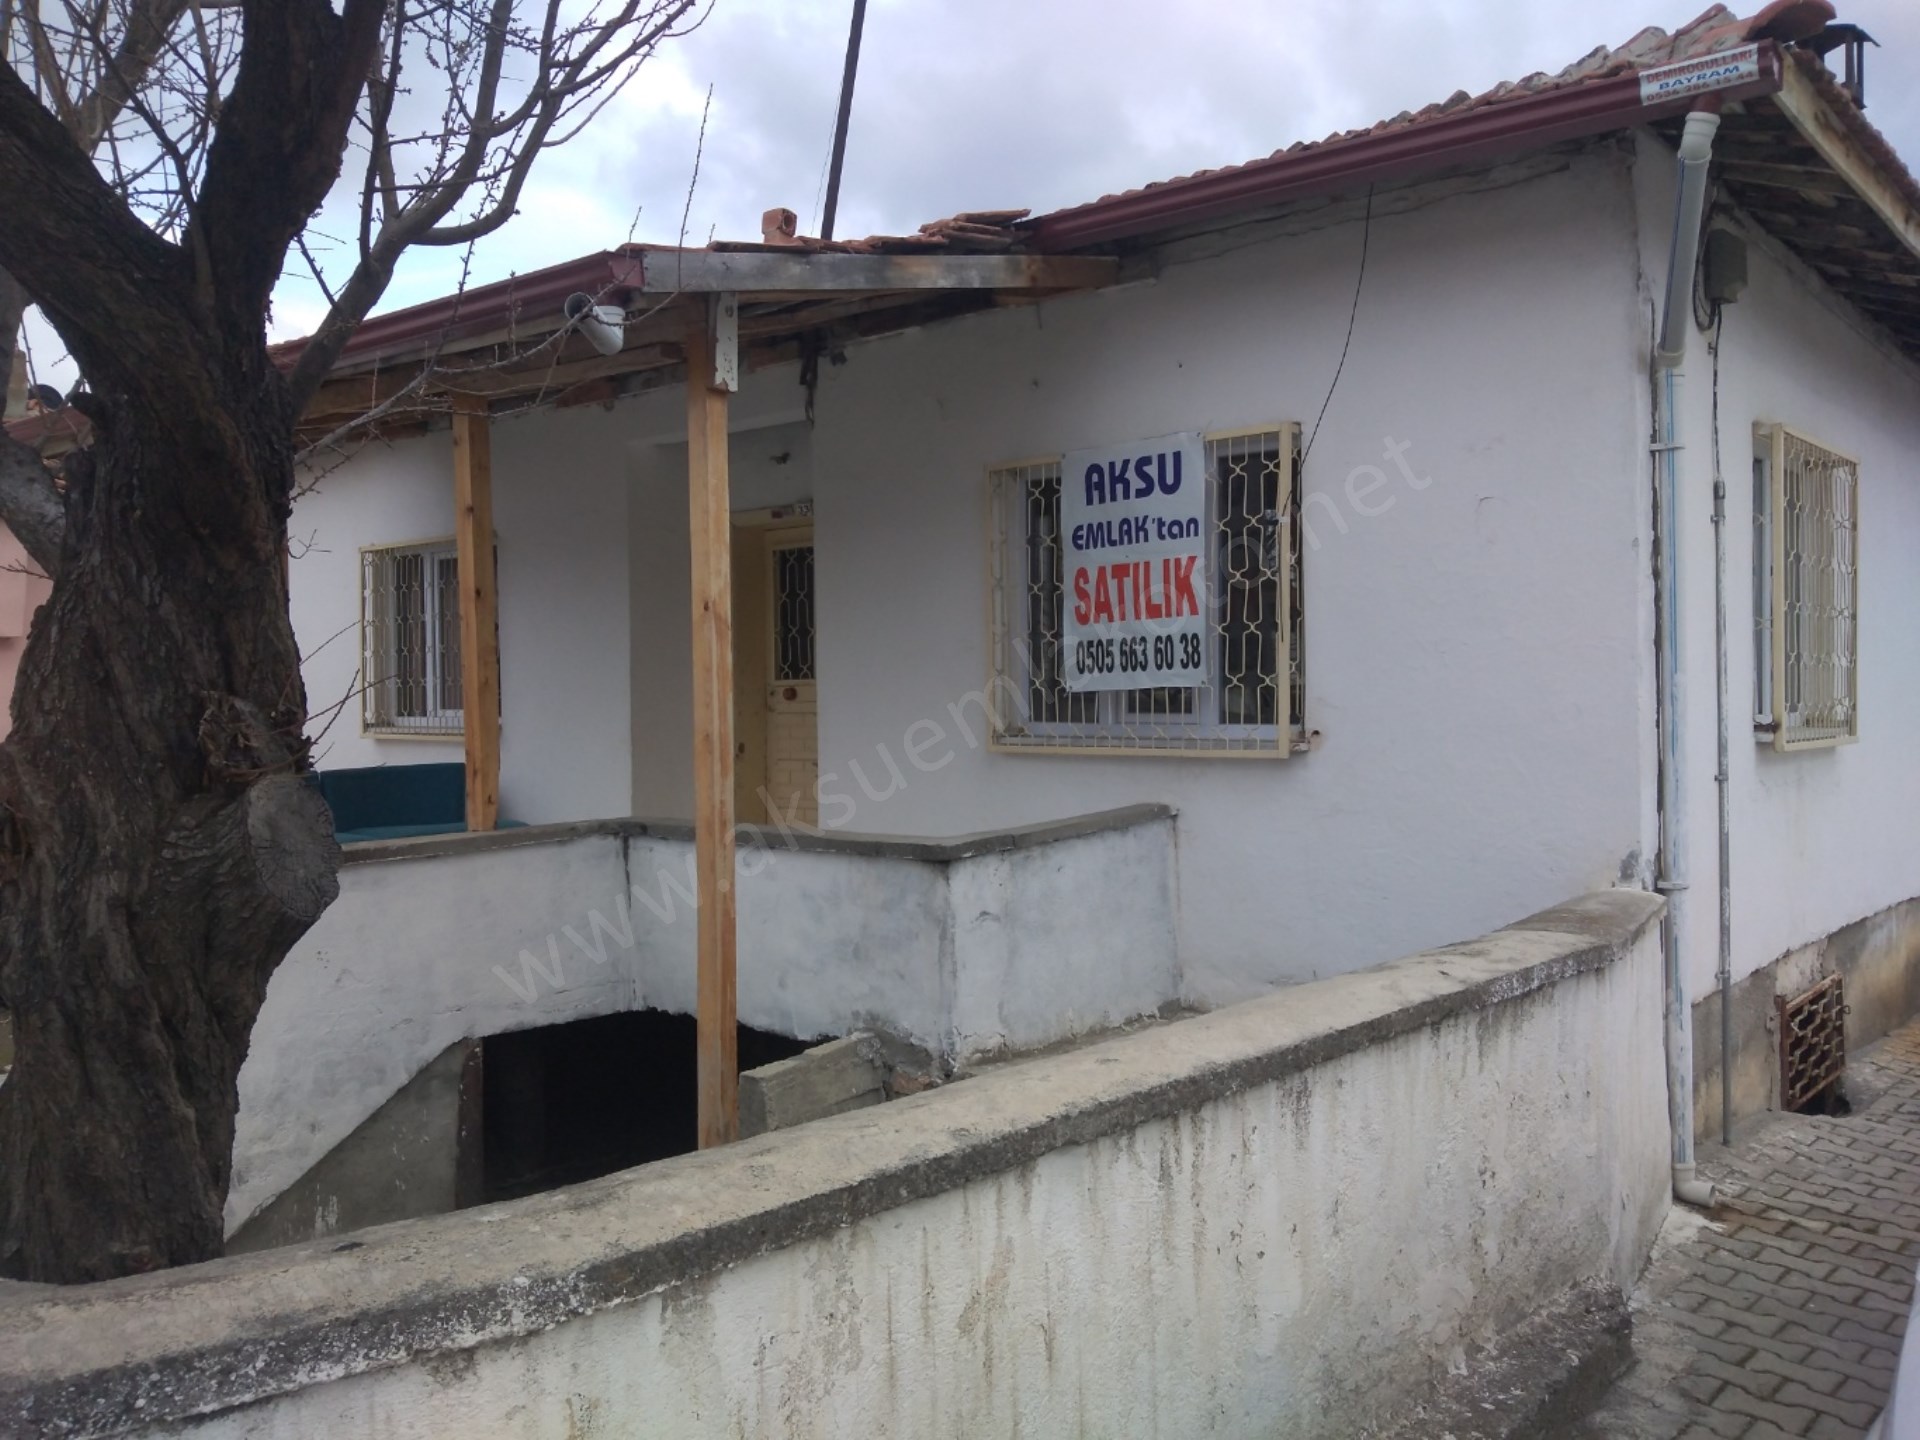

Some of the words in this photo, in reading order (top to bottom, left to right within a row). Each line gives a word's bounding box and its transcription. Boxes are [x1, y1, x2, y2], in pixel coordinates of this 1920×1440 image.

[1659, 65, 1740, 90] BAYRAM
[1084, 450, 1183, 506] AKSU
[1071, 514, 1200, 551] EMLAK'tan
[1073, 555, 1200, 627] SATILIK
[1076, 637, 1115, 675] 0505
[1119, 635, 1149, 673] 663
[1153, 633, 1175, 671] 60
[1179, 632, 1201, 670] 38
